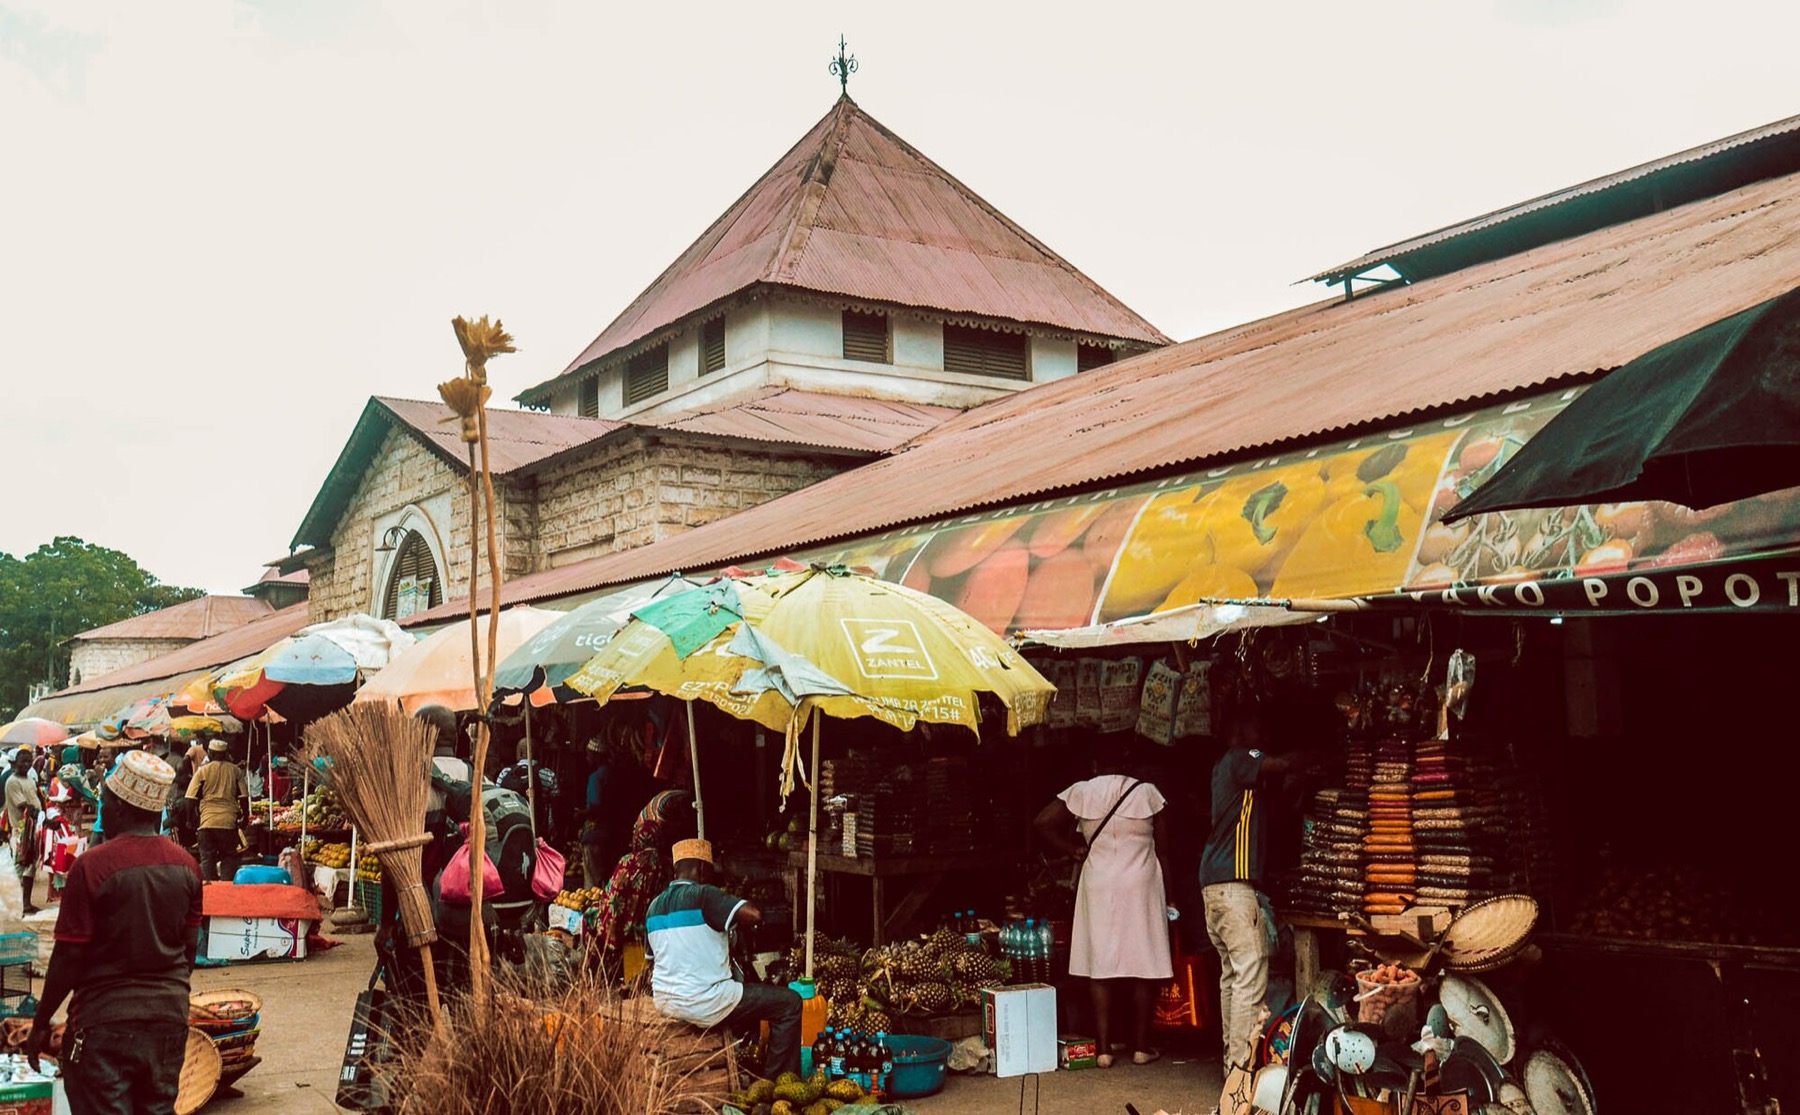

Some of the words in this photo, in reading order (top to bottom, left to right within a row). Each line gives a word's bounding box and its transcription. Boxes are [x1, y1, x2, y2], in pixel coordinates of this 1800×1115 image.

[1583, 571, 1800, 607] POPOT
[860, 628, 916, 654] Z
[866, 658, 926, 670] ZANTEL
